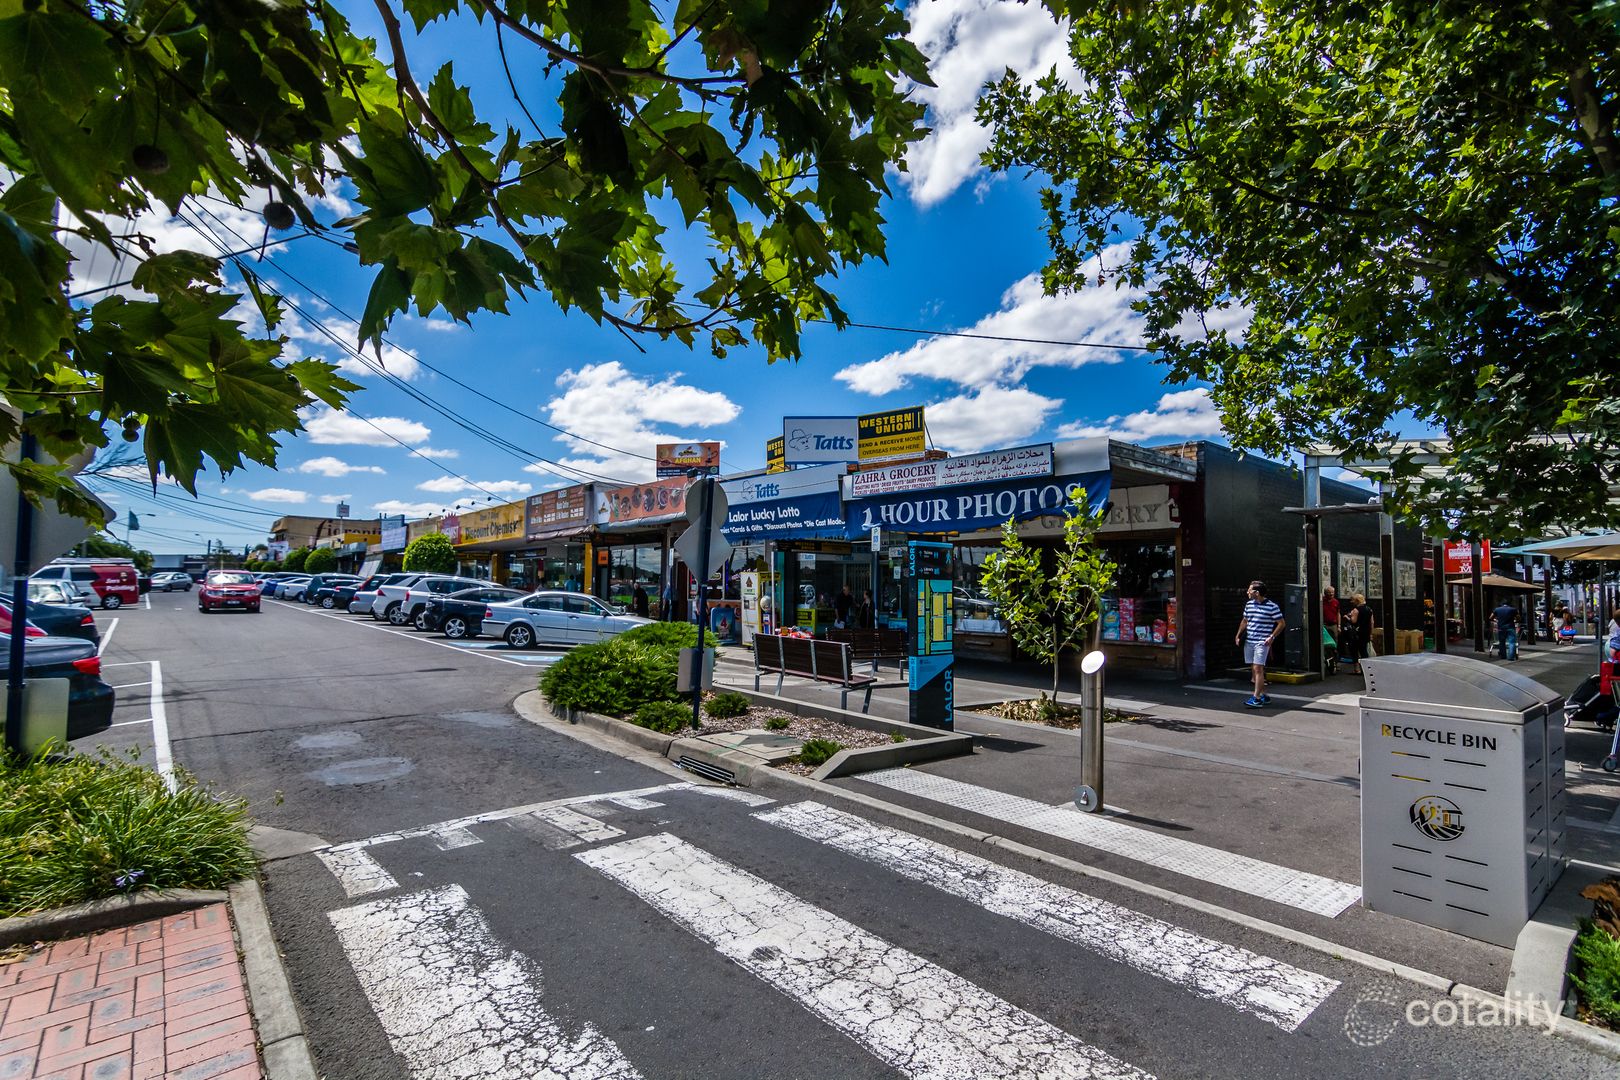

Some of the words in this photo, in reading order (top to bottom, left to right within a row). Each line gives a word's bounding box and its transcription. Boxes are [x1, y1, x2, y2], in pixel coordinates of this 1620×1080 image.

[860, 412, 912, 428] WESTERN
[876, 422, 912, 434] UNION
[768, 440, 784, 451] WESTE
[813, 434, 854, 450] Tatts
[971, 456, 990, 468] للمواد
[992, 452, 1016, 465] الزهراء
[1018, 449, 1044, 460] محلات
[945, 459, 969, 471] الغذائية
[855, 471, 886, 485] ZAHRA
[890, 464, 938, 480] GROCERY
[755, 483, 780, 498] Tatts
[862, 508, 881, 531] 1
[880, 499, 949, 524] HOUR
[957, 482, 1083, 520] PHOTOS
[728, 512, 748, 523] Lalor
[750, 509, 775, 521] Lucky
[778, 507, 800, 518] Lotto
[827, 518, 845, 526] Mode
[465, 526, 489, 540] Discount
[490, 520, 518, 536] Chemist
[1382, 723, 1456, 746] RECYCLE
[1462, 734, 1497, 750] BIN
